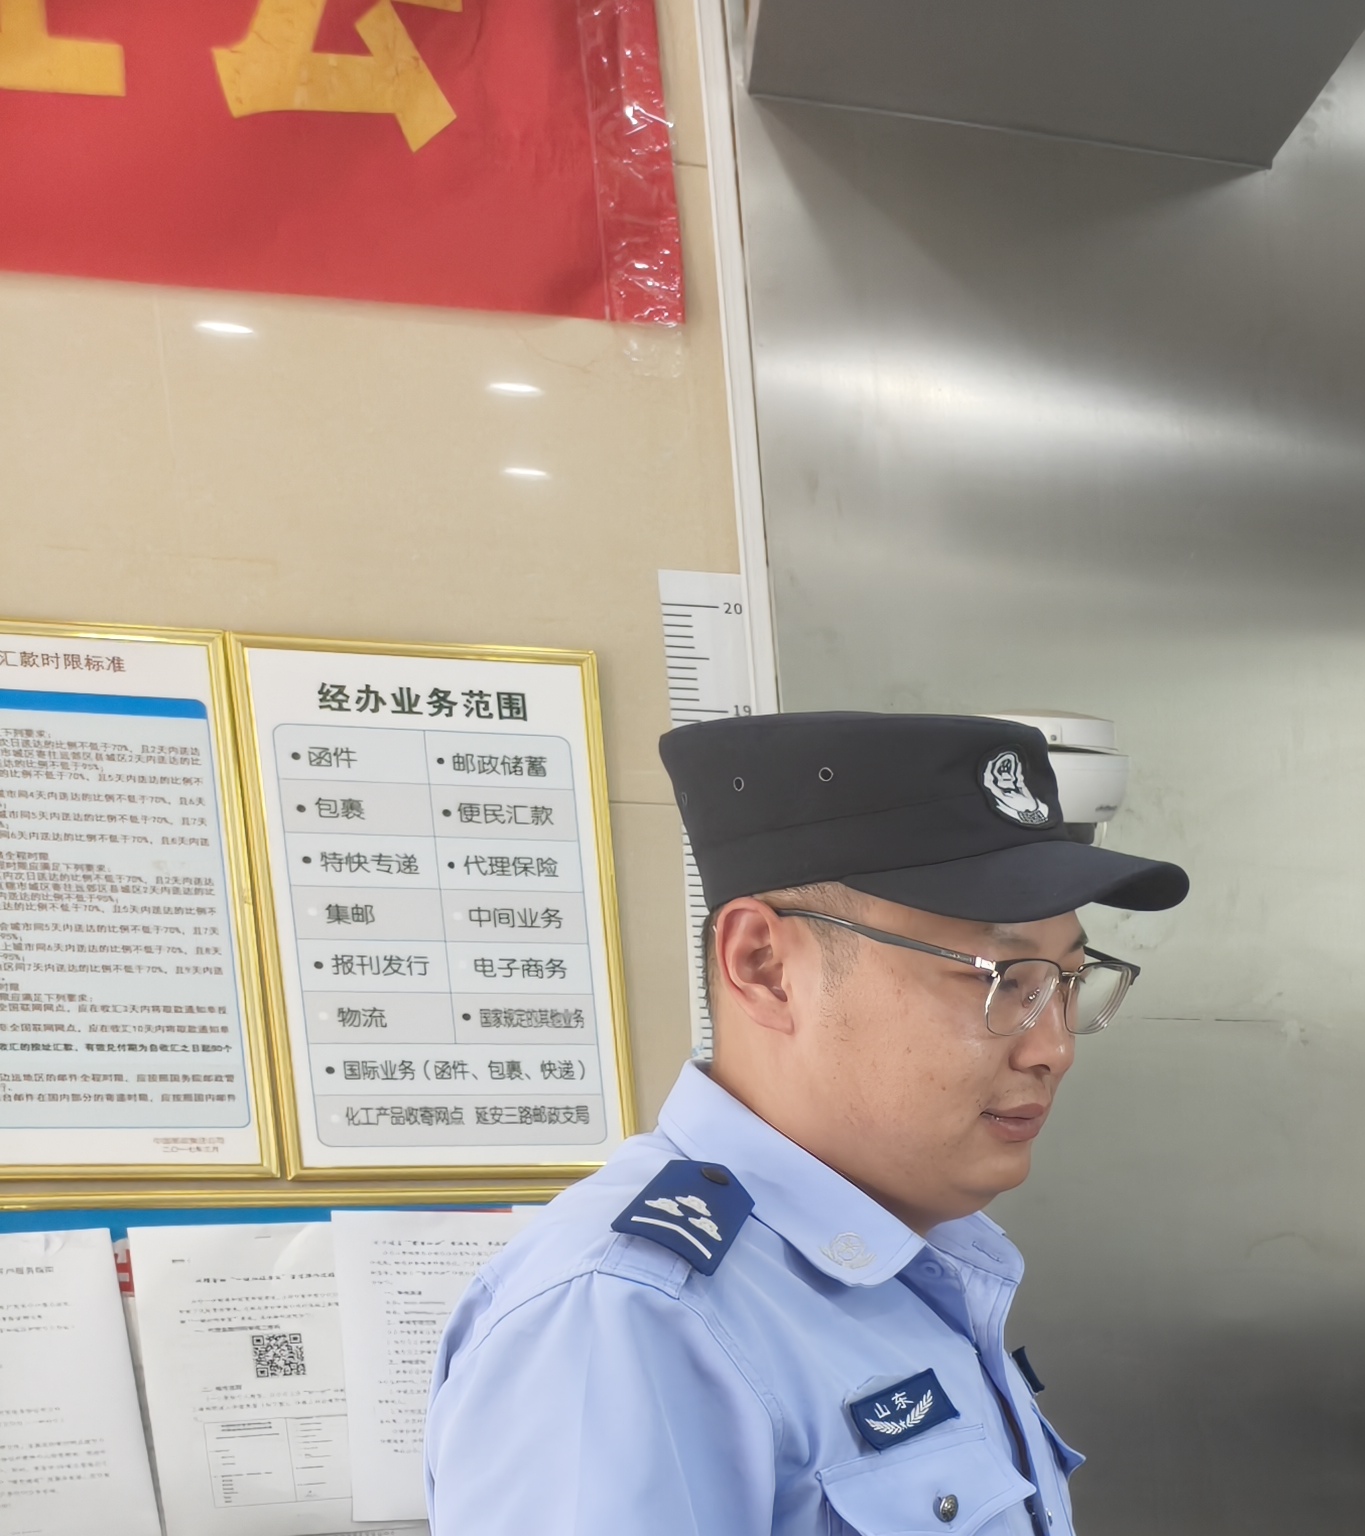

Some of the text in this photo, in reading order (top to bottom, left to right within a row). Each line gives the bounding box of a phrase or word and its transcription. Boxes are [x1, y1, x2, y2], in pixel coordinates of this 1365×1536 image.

[0, 650, 127, 673] 汇款时限标准
[317, 682, 528, 722] 经办业务范围
[307, 746, 358, 769] 函件
[451, 752, 548, 778] 邮政储蓄
[314, 797, 366, 821] 包裹
[456, 802, 555, 826] 便民汇款
[320, 851, 421, 876] 特快专递
[463, 855, 560, 879] 代理保险
[325, 903, 376, 926] 集邮
[468, 907, 564, 930] 中间业务
[330, 954, 430, 978] 报刊发行
[472, 957, 568, 980] 电子商务
[337, 1007, 388, 1029] 物流
[872, 1390, 914, 1420] 山东
